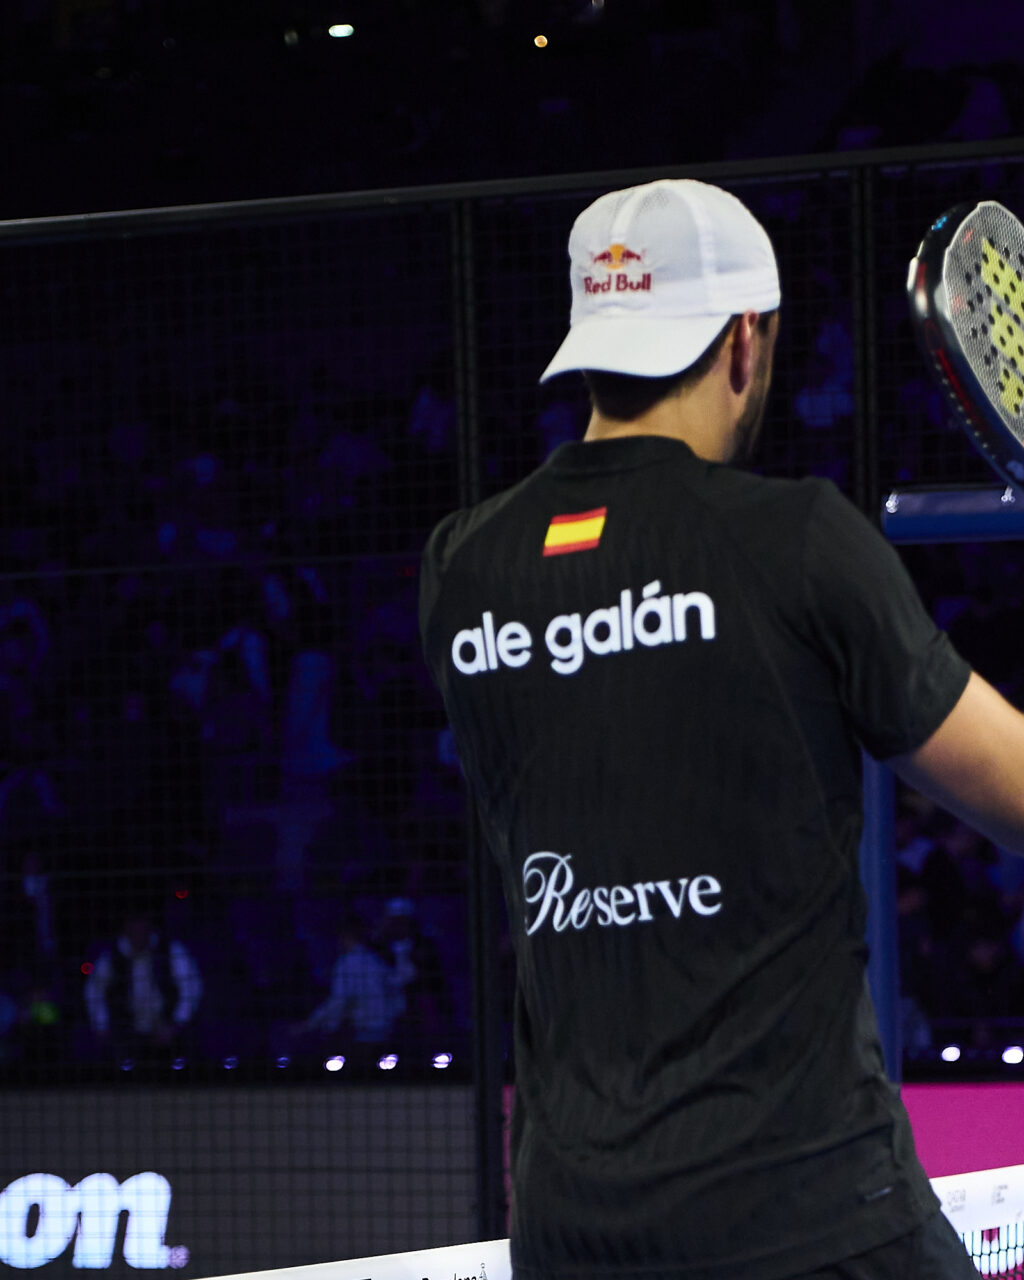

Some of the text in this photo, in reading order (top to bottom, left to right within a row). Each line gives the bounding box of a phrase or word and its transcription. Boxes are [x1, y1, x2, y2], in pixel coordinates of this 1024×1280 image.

[583, 272, 652, 295] Red Bull
[451, 579, 717, 675] ale galán
[523, 850, 723, 936] Reserve
